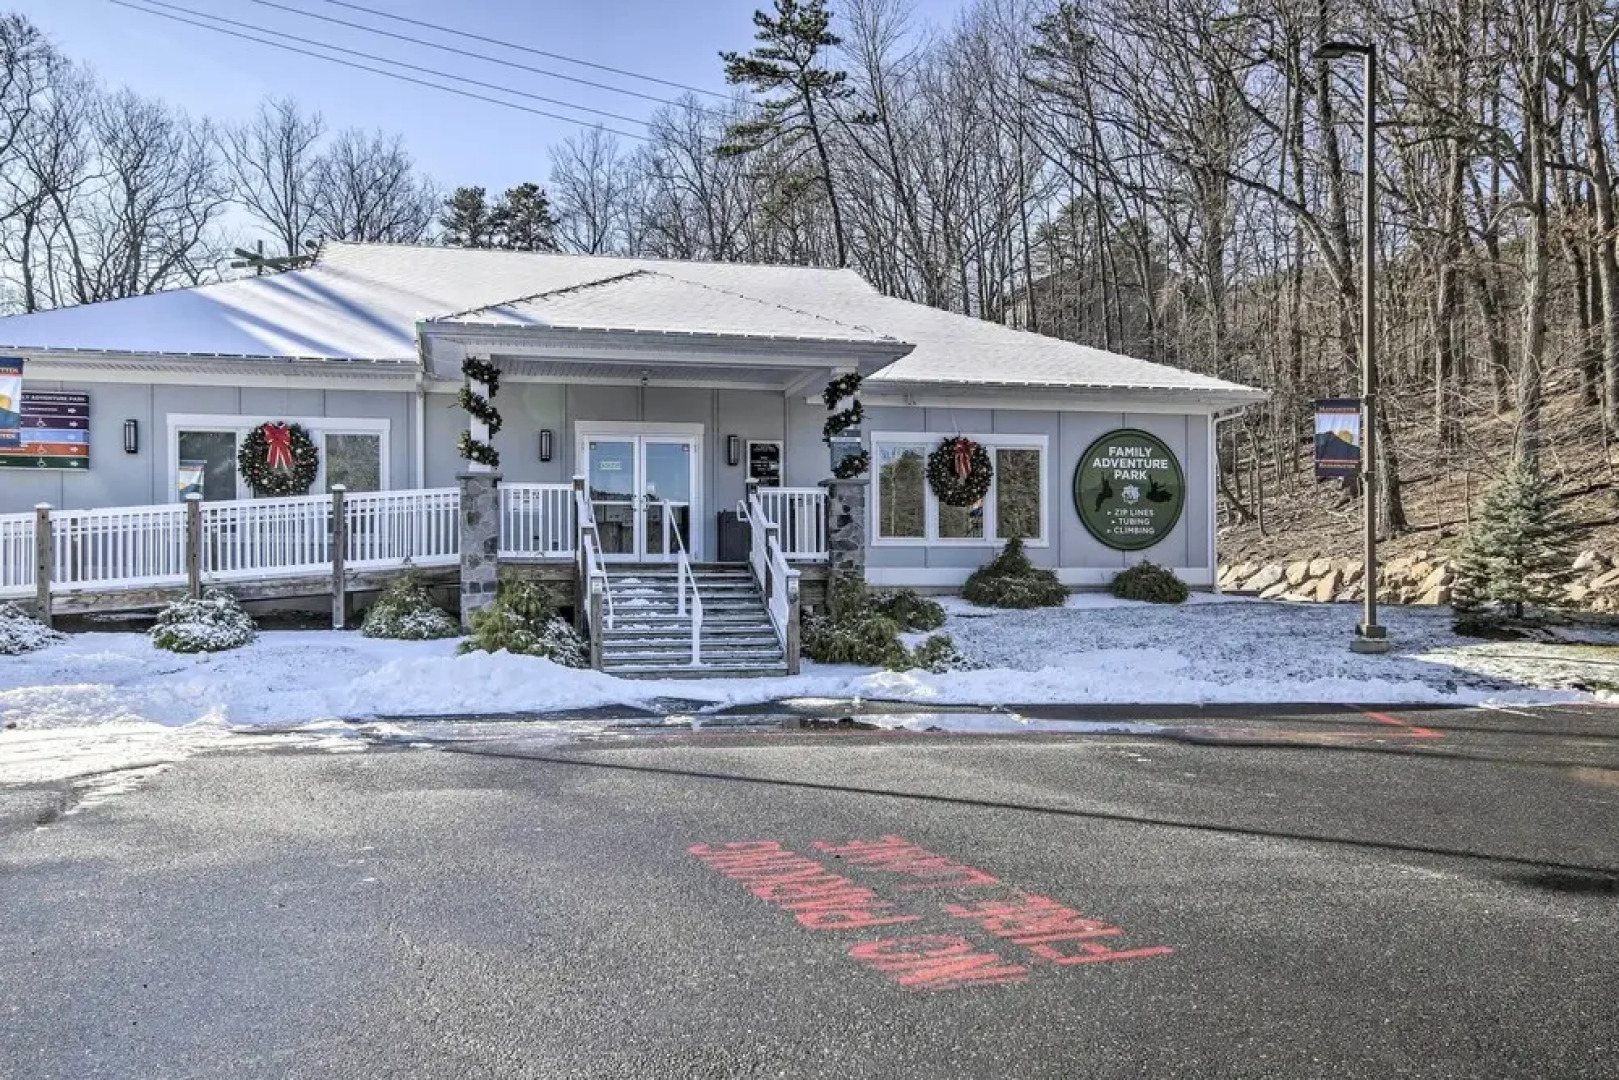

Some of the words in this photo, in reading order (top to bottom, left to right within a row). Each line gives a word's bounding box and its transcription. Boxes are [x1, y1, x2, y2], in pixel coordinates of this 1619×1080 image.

[1092, 458, 1168, 469] ADVENTURE
[1108, 446, 1152, 458] FAMILY
[1114, 469, 1147, 480] PARK
[686, 840, 922, 931] PARKING
[811, 834, 999, 892] LANE
[943, 893, 1175, 966] FIRE
[849, 934, 1029, 987] NO
